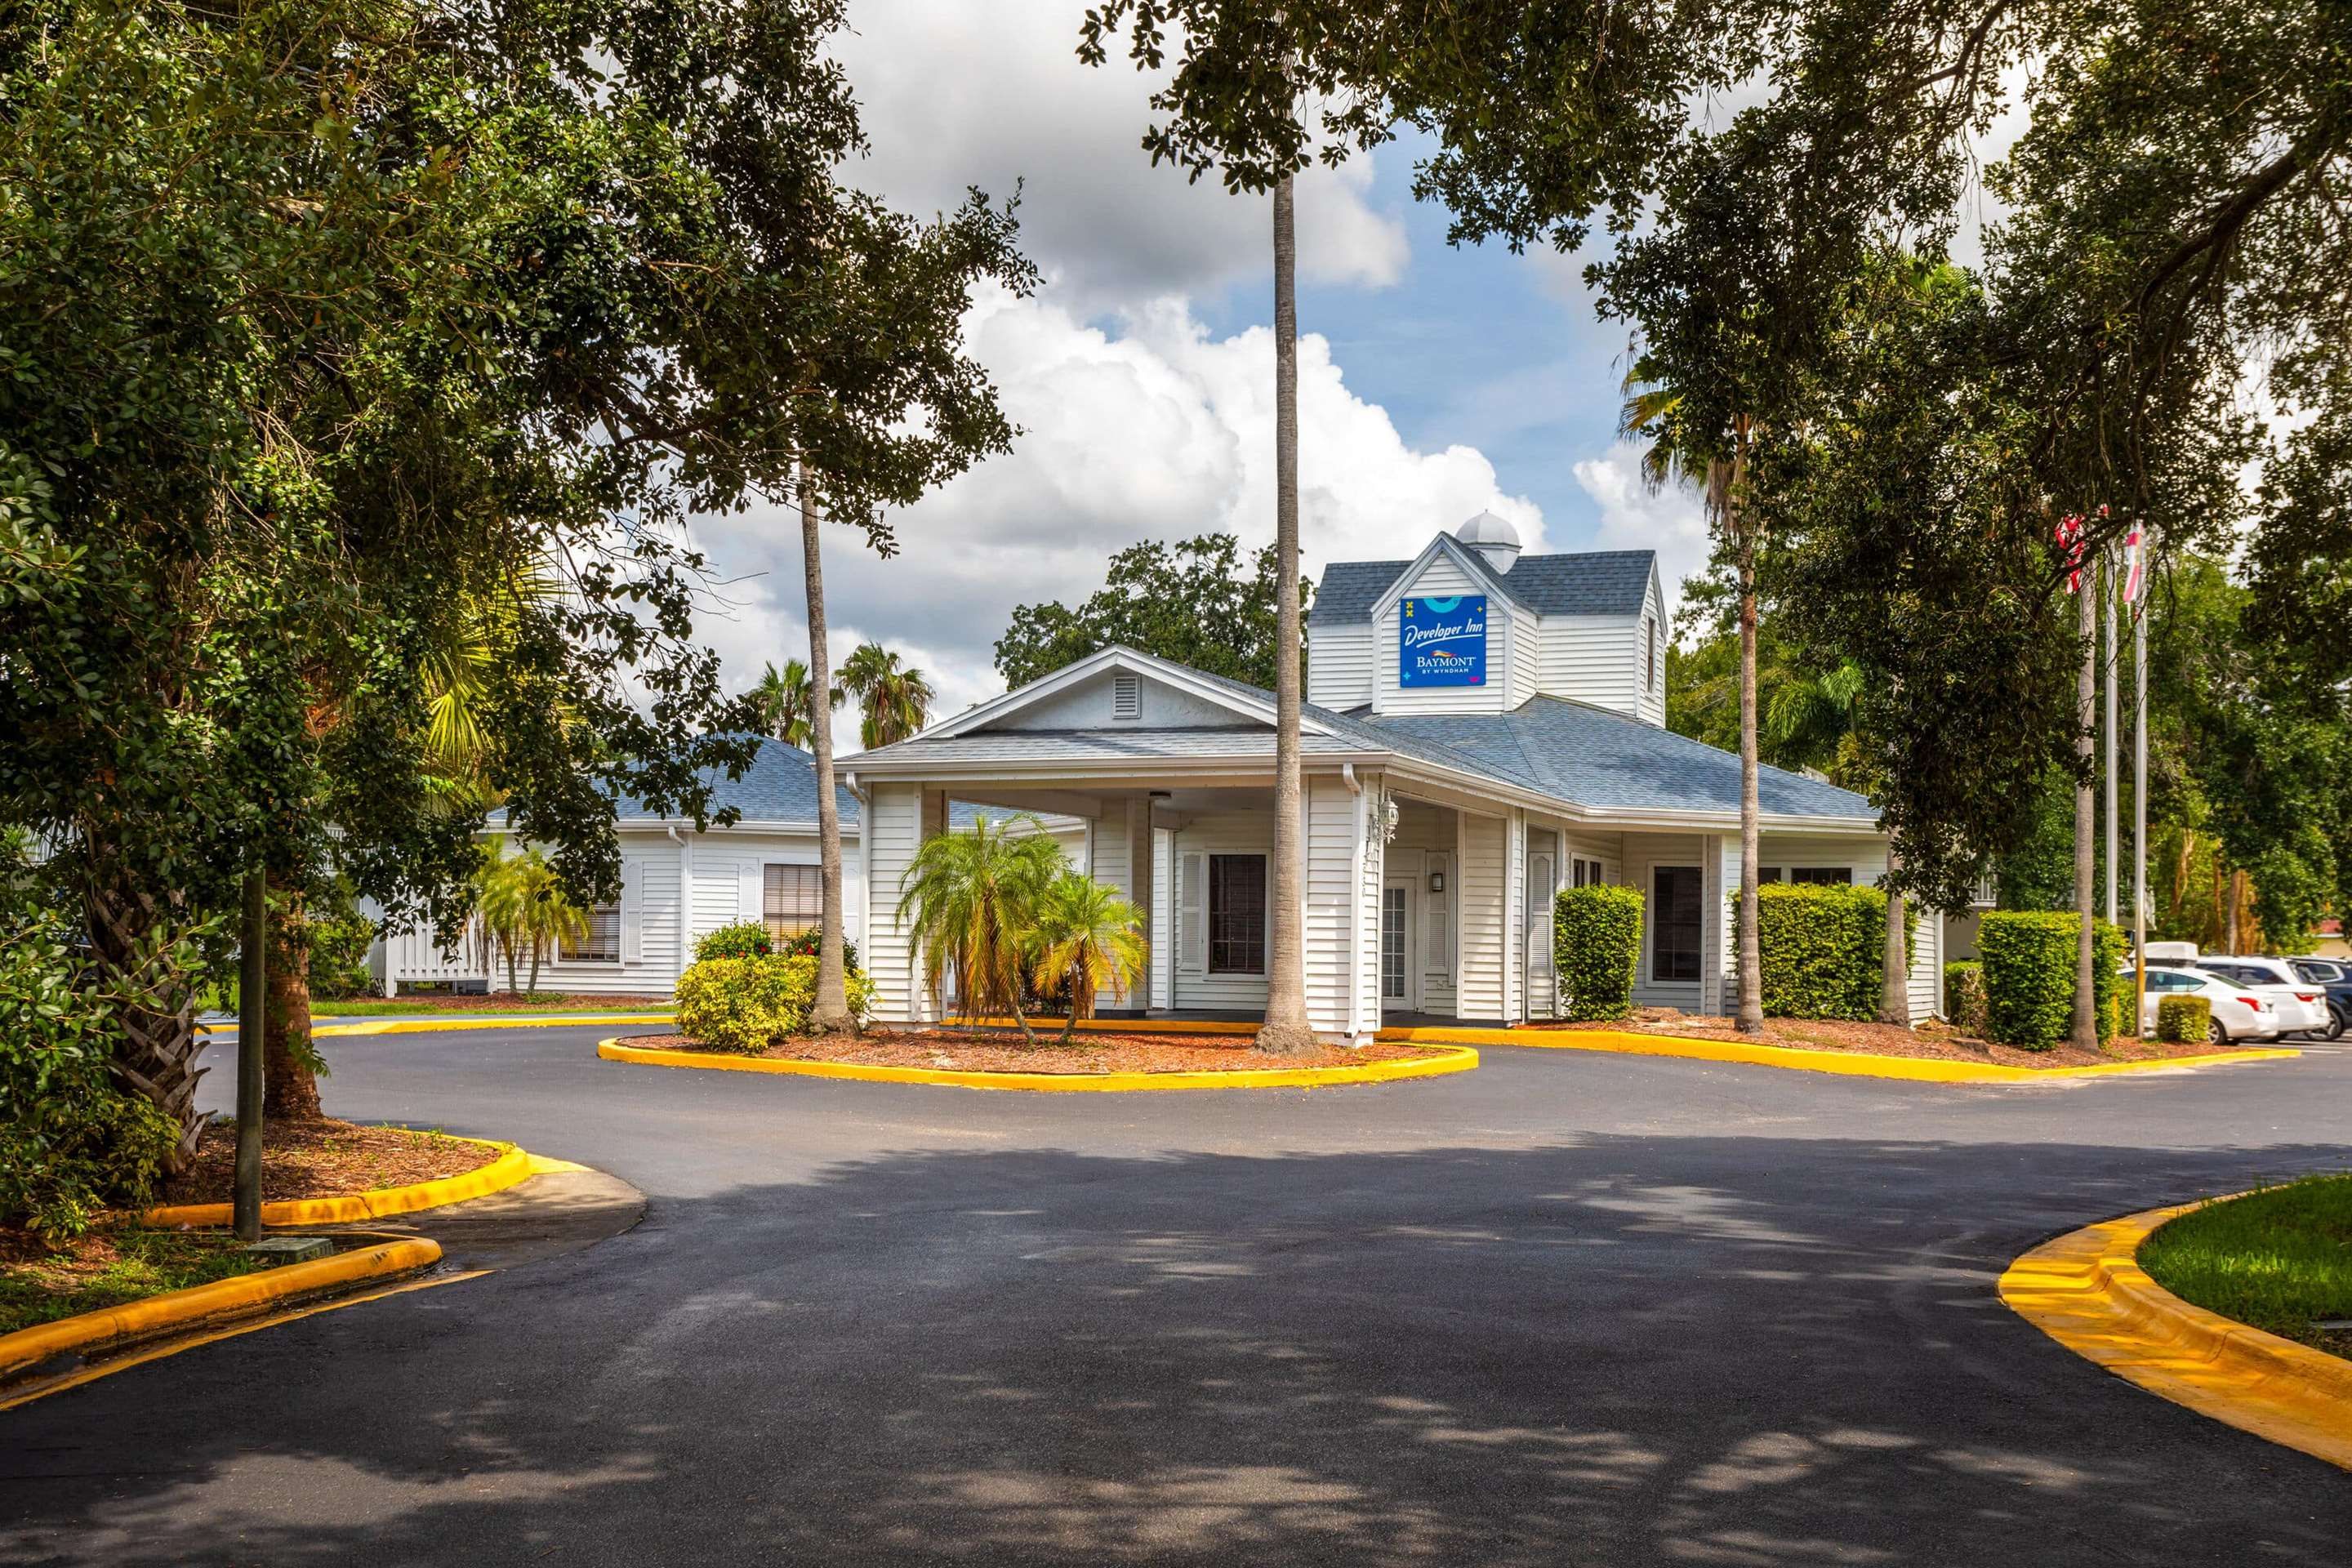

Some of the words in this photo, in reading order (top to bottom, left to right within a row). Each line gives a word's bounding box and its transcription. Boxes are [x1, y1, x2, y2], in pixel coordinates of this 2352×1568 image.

[1405, 622, 1463, 646] Developer
[1465, 618, 1482, 633] Inn
[1417, 657, 1473, 667] BAYMONT
